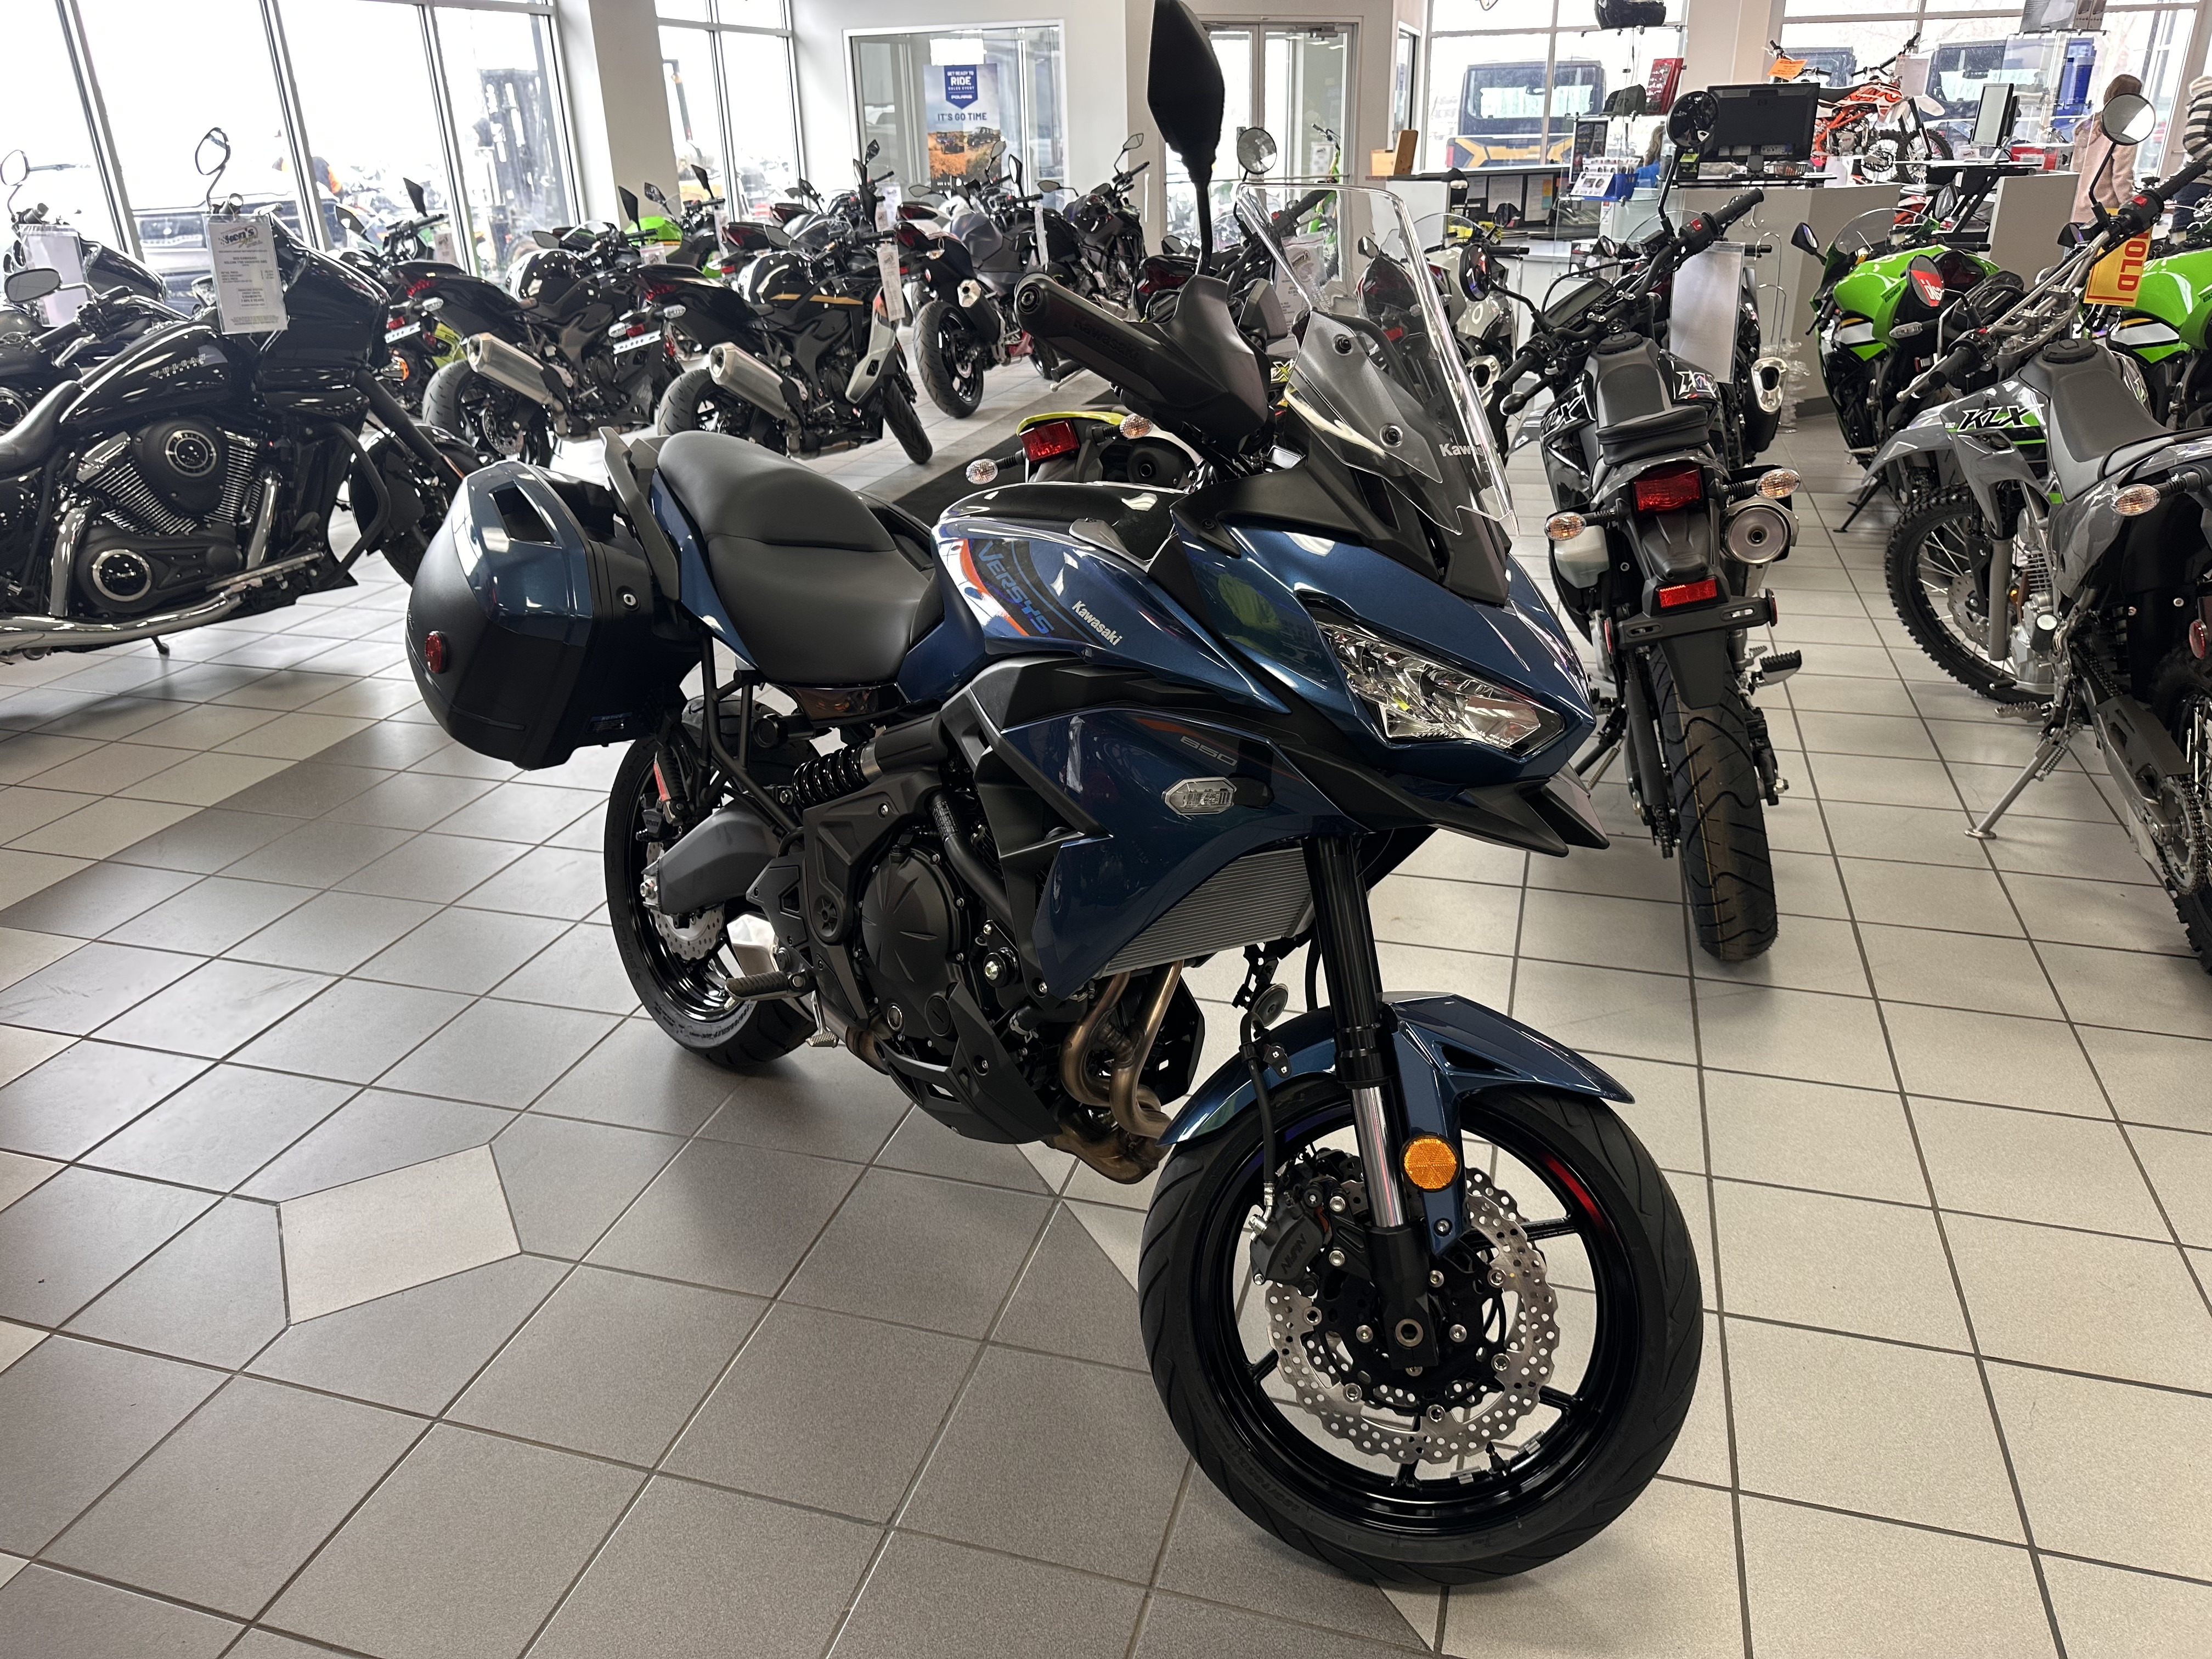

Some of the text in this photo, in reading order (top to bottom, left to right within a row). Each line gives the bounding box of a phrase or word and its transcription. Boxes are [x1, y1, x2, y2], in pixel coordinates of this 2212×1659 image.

[950, 76, 971, 86] RIDE
[938, 113, 952, 121] IT'S
[968, 112, 987, 121] TIME
[149, 353, 205, 377] VULCAN
[1957, 404, 2044, 432] KLX
[1072, 600, 1122, 646] Kawasaki
[1180, 736, 1238, 766] 650
